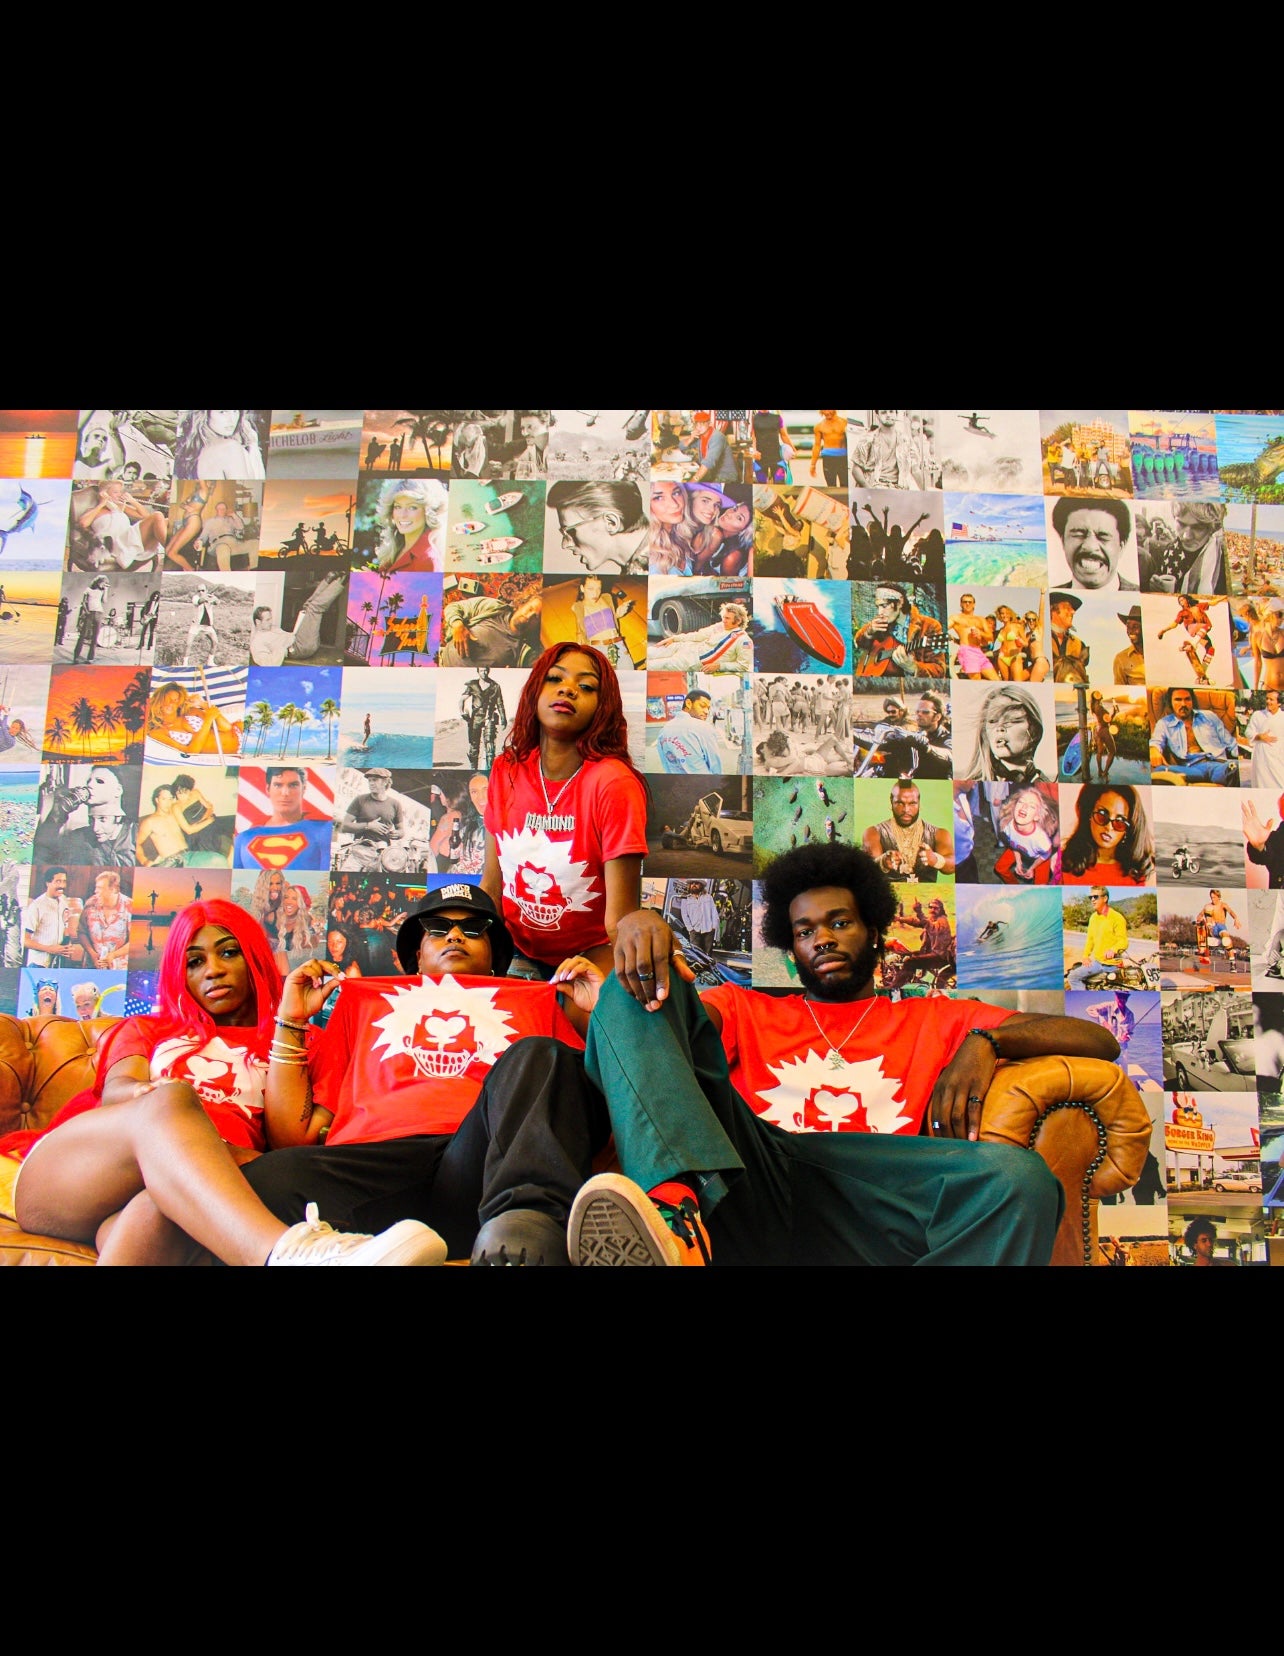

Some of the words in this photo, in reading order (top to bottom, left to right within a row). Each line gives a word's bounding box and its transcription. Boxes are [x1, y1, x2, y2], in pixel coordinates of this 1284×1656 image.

[319, 430, 353, 444] Light
[526, 812, 576, 832] DIAMOND
[440, 884, 471, 896] POWER
[1165, 1126, 1195, 1140] BURGER
[1197, 1130, 1213, 1142] KING
